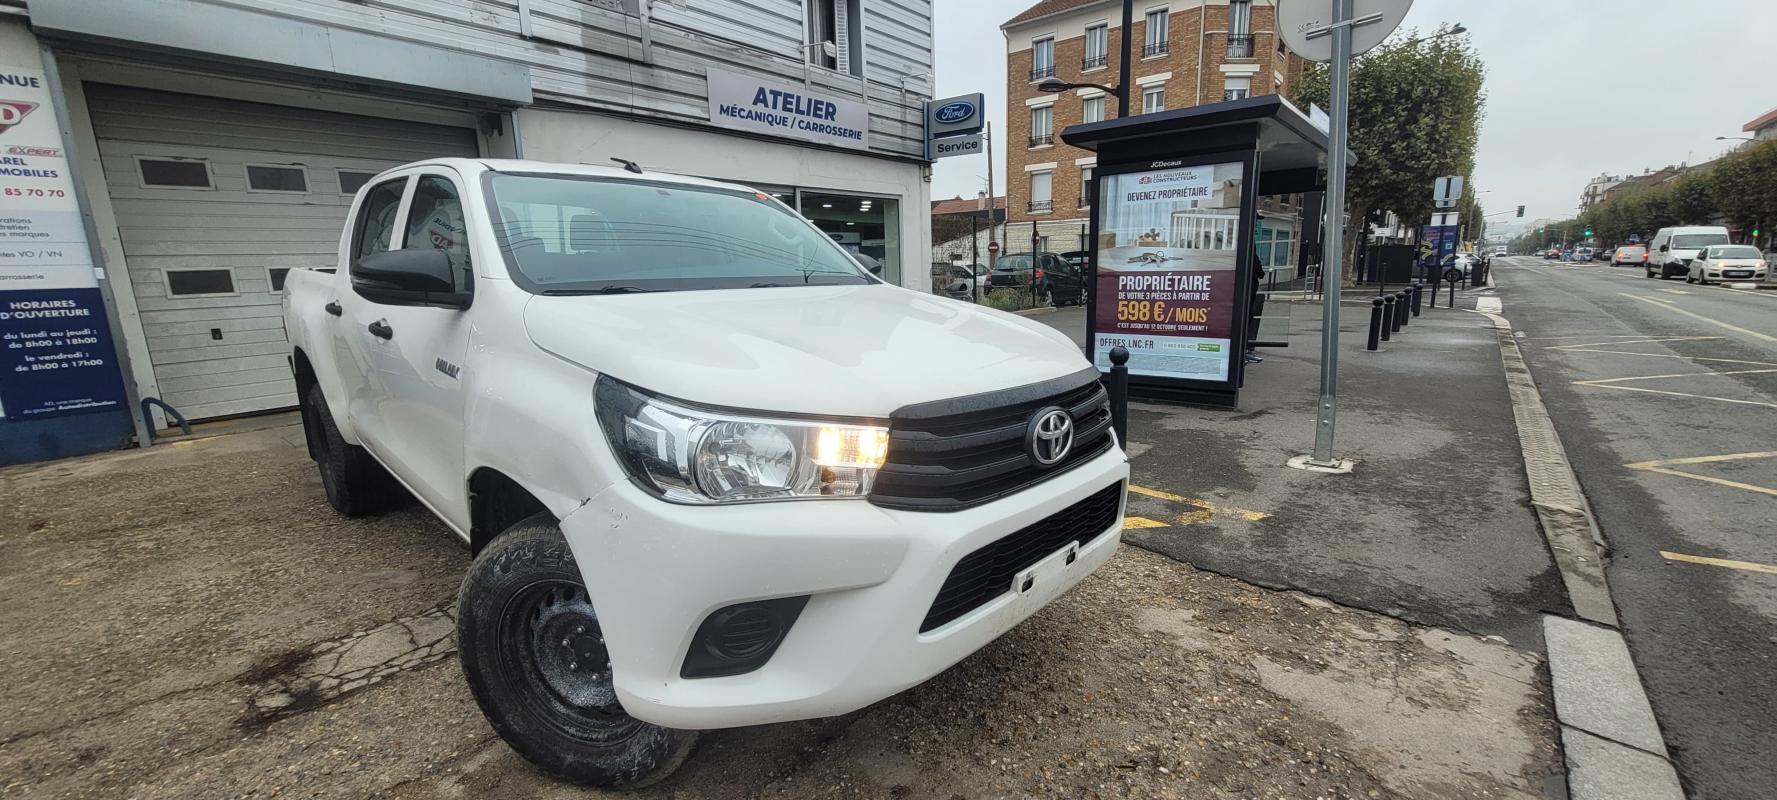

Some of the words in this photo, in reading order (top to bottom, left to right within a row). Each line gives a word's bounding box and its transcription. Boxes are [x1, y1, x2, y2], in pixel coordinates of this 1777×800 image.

[752, 87, 837, 121] ATELIER
[941, 105, 966, 119] Ford
[719, 104, 788, 127] MÉCANIQUE
[790, 117, 796, 129] /
[798, 120, 862, 140] CARROSSERIE
[937, 141, 978, 153] Service
[1150, 160, 1182, 168] JCDecaux
[1153, 175, 1197, 184] CONSTRUCTEURS
[4, 188, 22, 196] 85
[25, 189, 44, 198] 70
[48, 190, 65, 198] 70
[1127, 190, 1157, 202] DEVENEZ
[1158, 186, 1209, 199] PROPRIÉTAIRE
[1118, 272, 1212, 291] PROPRIÉTAIRE
[1127, 292, 1145, 300] VOTRE
[1145, 292, 1150, 300] 3
[1151, 291, 1172, 300] PIÈCES
[1172, 291, 1177, 300] À
[1178, 292, 1200, 300] PARTIR
[1201, 292, 1210, 300] DE
[9, 300, 77, 310] HORAIRES
[1117, 300, 1151, 321] 598
[0, 308, 90, 320] D'OUVERTURE
[20, 330, 48, 339] lundi
[66, 328, 91, 337] jeudi
[1177, 324, 1204, 332] SEULEMENT
[25, 340, 53, 348] 8h00
[66, 337, 97, 345] 18h00
[1099, 338, 1154, 349] OFFRES.LNC.FR
[38, 352, 83, 361] vendredi
[31, 362, 59, 371] 8h00
[71, 359, 103, 367] 17h00
